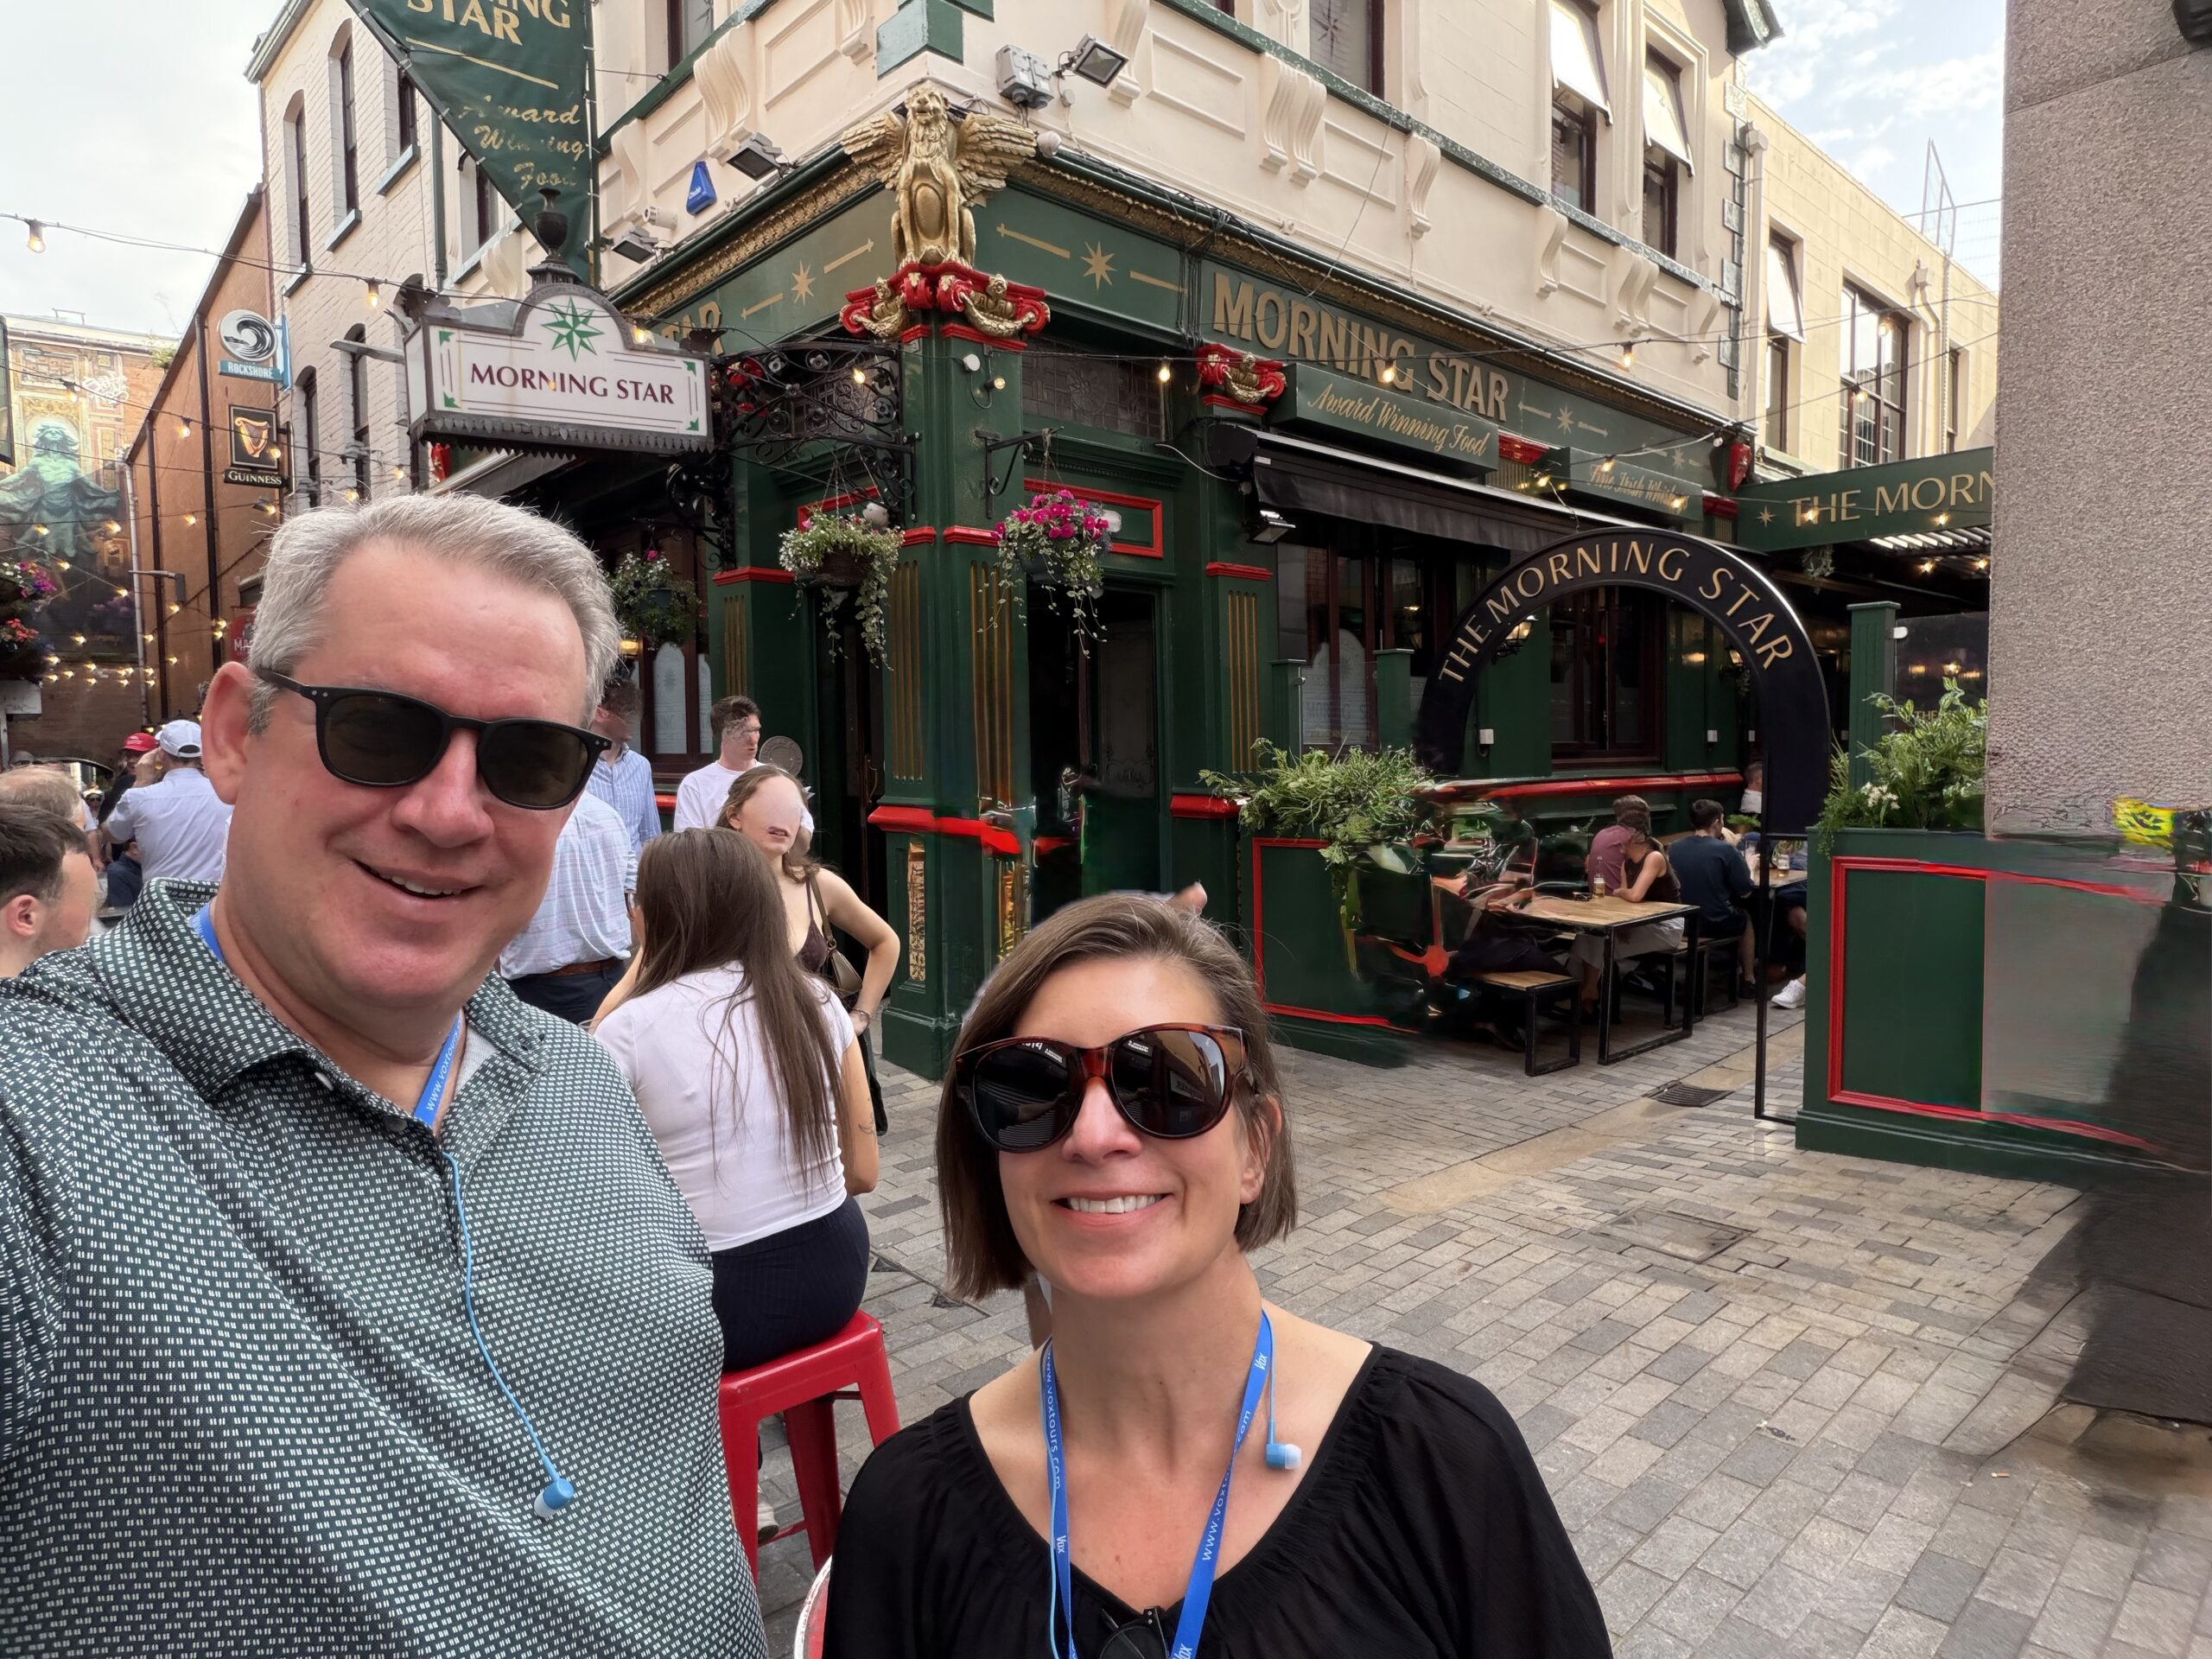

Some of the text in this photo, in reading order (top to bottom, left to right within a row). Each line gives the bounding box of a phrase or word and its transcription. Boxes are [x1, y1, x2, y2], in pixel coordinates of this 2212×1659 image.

[1213, 272, 1510, 423] MORNING STAR
[227, 361, 274, 379] ROCKSHORE
[470, 363, 675, 404] MORNING STAR
[1306, 383, 1491, 457] Award Winning Food
[228, 470, 283, 486] GUINNESS
[1787, 489, 1861, 528] THE
[1438, 540, 1794, 683] THE MORNING STAR
[1254, 1351, 1268, 1371] Vox
[1056, 1535, 1067, 1554] Vox
